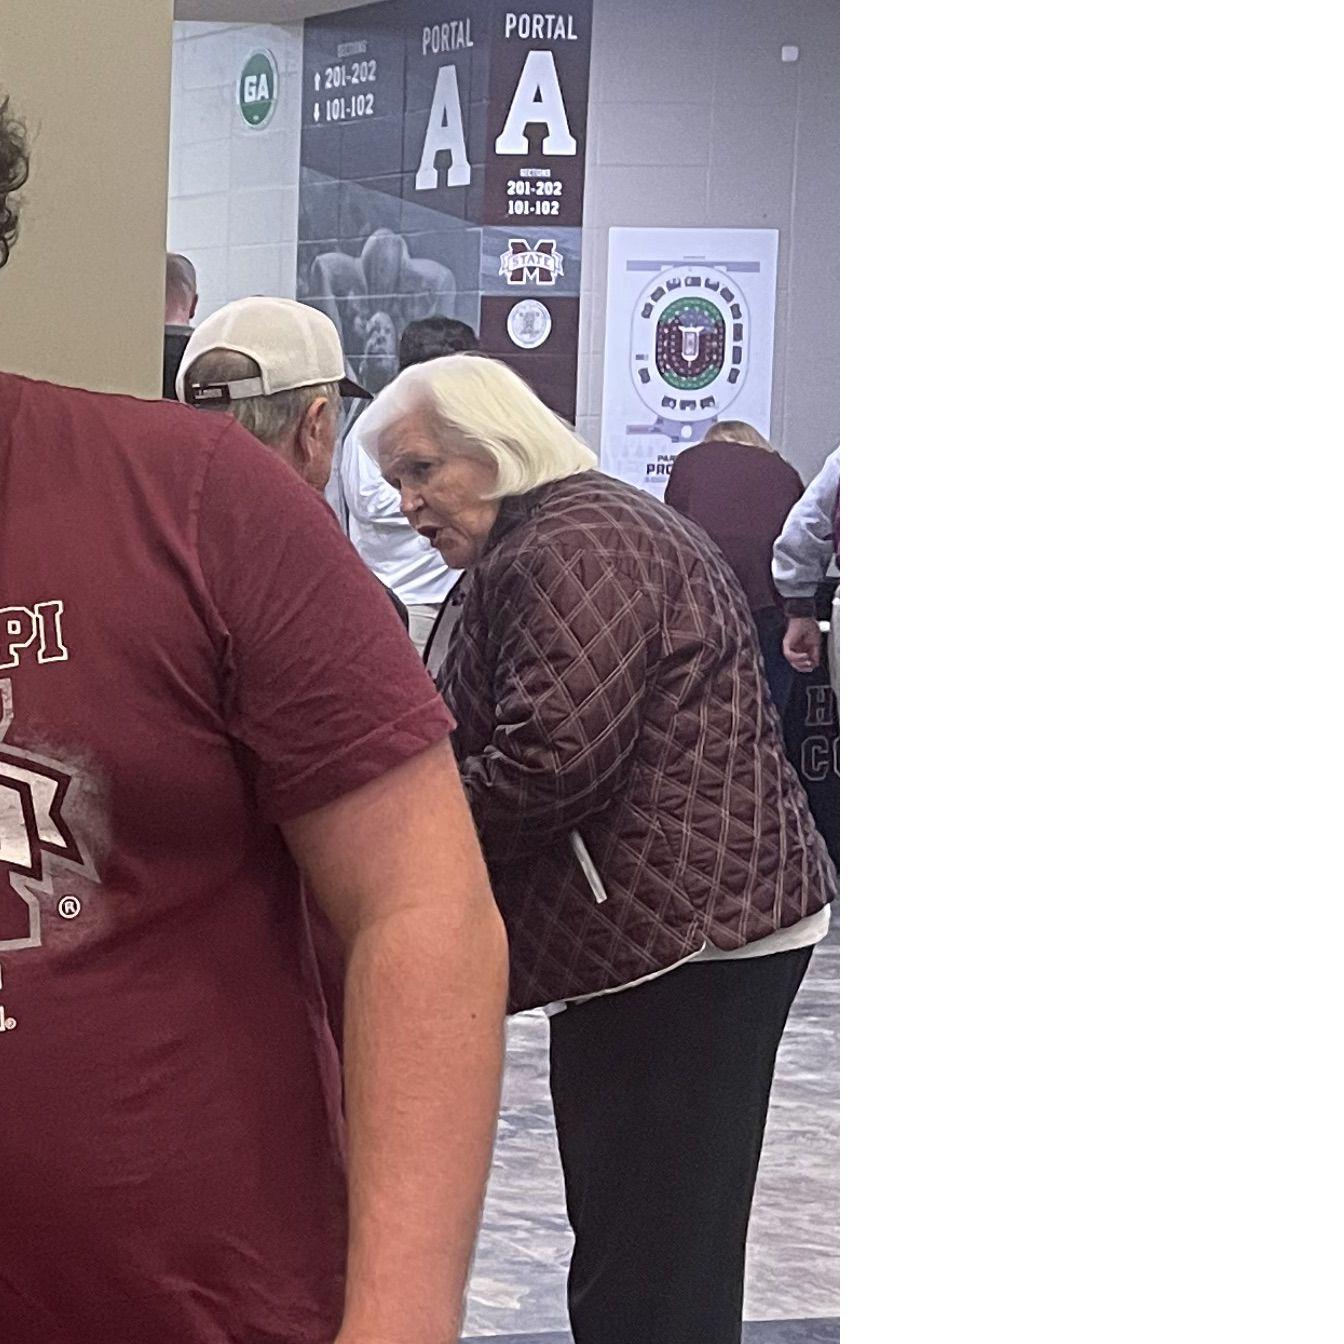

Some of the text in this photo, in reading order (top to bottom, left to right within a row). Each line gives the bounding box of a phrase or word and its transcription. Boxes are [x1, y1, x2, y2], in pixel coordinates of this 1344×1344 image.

[422, 18, 474, 55] PORTAL
[504, 13, 578, 40] PORTAL
[243, 73, 269, 103] GA
[324, 59, 377, 89] 201-202
[326, 93, 374, 121] 101-102
[495, 50, 576, 155] A
[415, 64, 471, 190] A
[507, 180, 562, 196] 201-202
[508, 200, 560, 215] 101-102
[511, 251, 552, 269] STATE
